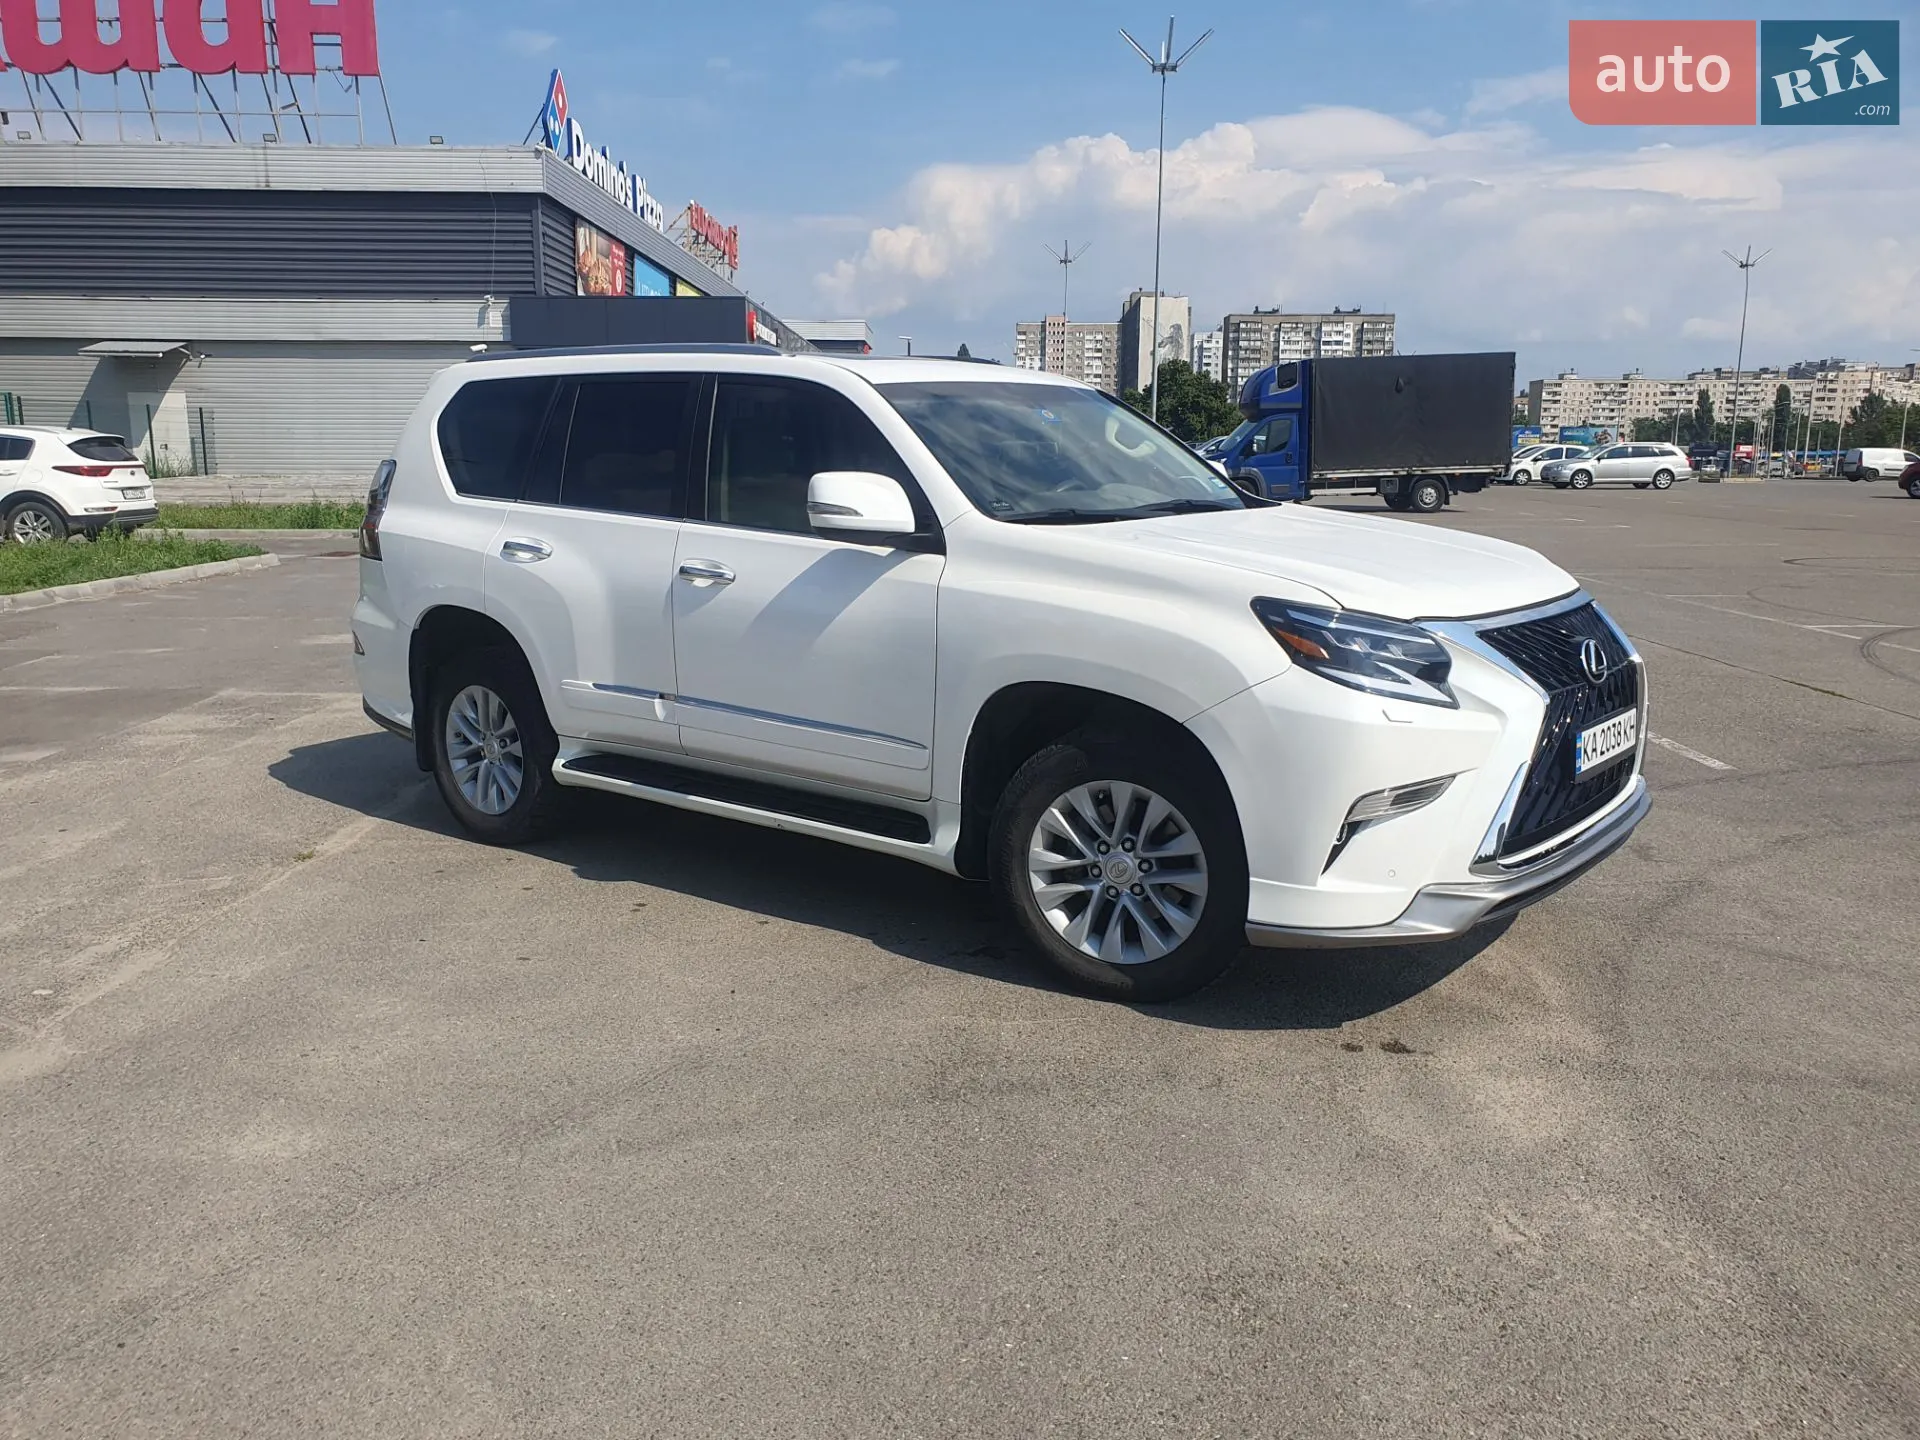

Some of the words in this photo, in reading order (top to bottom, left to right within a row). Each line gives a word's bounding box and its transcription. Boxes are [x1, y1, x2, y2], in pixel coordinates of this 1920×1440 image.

[569, 118, 633, 211] Domino's
[633, 174, 664, 232] Pizza
[1583, 732, 1598, 765] KA
[1600, 720, 1622, 756] 2038
